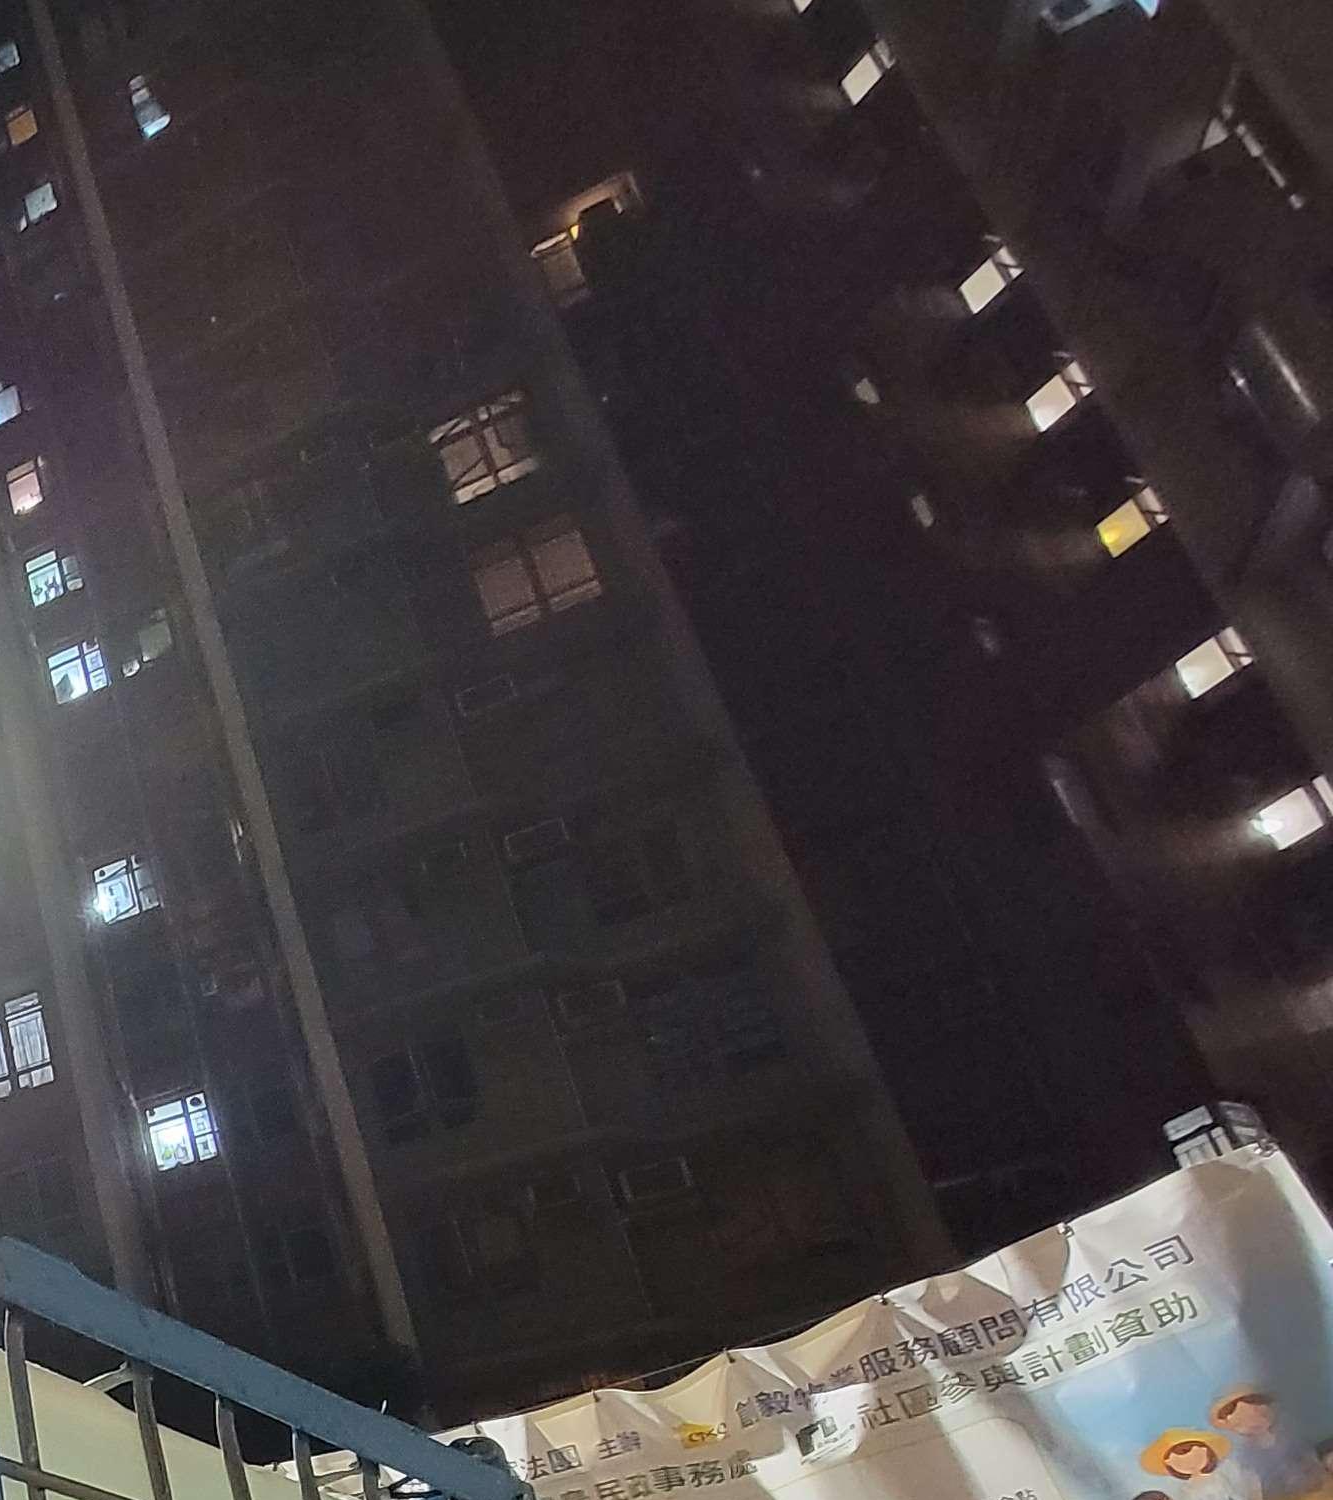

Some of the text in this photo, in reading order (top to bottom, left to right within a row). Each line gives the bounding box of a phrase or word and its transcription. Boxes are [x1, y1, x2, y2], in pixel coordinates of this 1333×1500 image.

[856, 1291, 1198, 1429] 社區參與計劃資助
